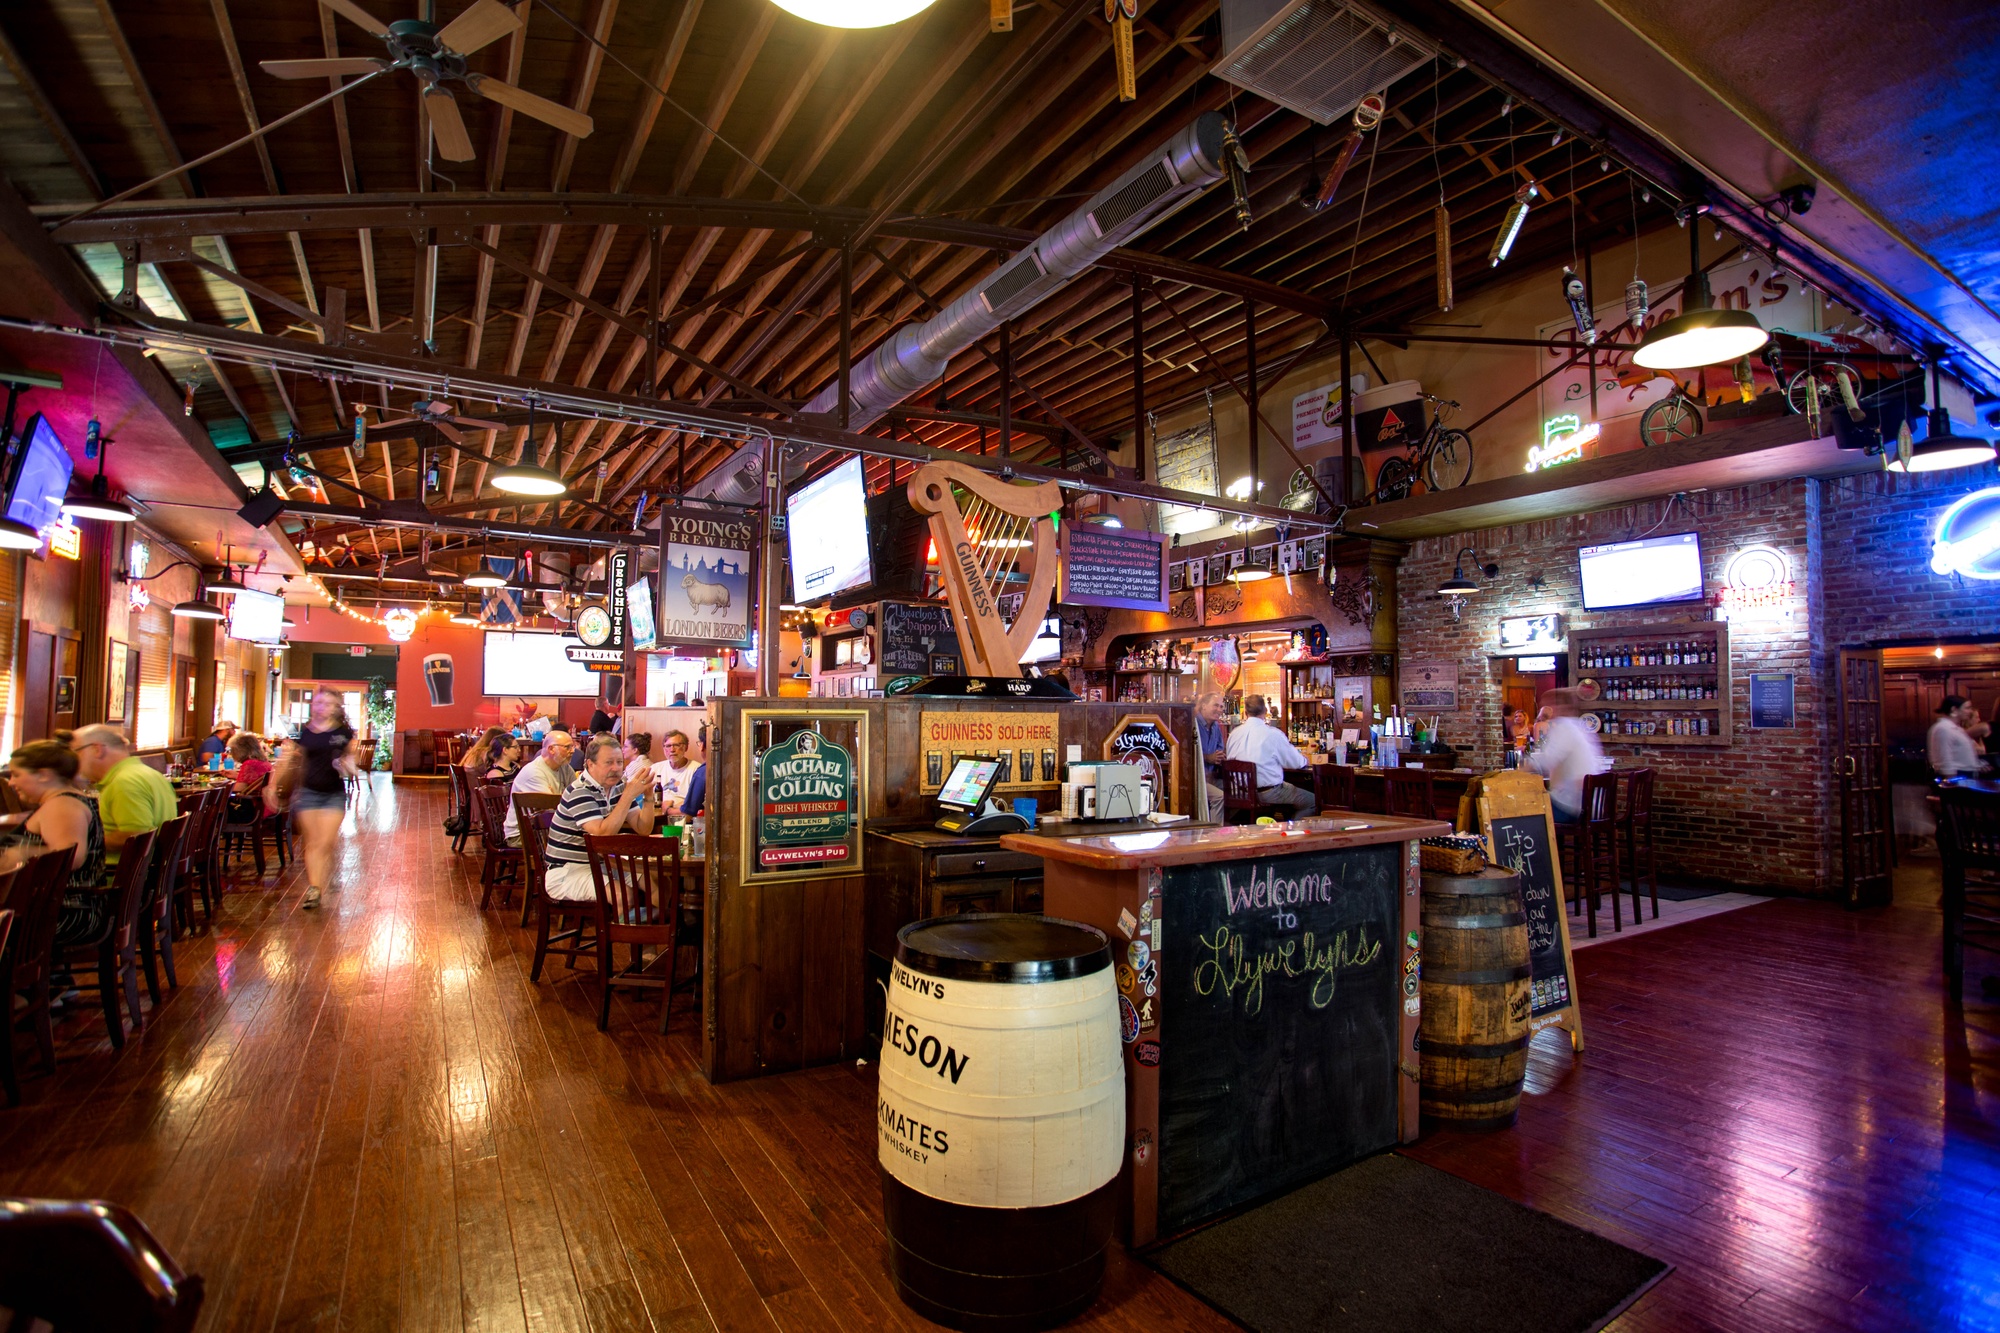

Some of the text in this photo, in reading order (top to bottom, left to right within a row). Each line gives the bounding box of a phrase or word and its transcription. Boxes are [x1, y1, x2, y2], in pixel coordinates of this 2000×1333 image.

[1124, 25, 1134, 94] DESCHUTES
[1359, 106, 1379, 120] KILLIAN'S
[1296, 394, 1324, 408] AMERICA'S
[1296, 407, 1322, 419] PREMIUM
[1296, 420, 1318, 432] QUALITY
[1296, 433, 1312, 442] BEER
[669, 516, 751, 540] YOUNG'S
[669, 532, 750, 550] BREWERY
[956, 542, 992, 618] GUINNESS
[614, 558, 626, 645] DESCHUTES
[666, 618, 746, 640] LONDON BEERS
[908, 618, 937, 636] happy
[572, 650, 624, 660] BREWERY
[1007, 683, 1032, 692] HARP
[931, 722, 1051, 741] GUINNESS SOLD HERE
[1115, 731, 1166, 751] Llywelyn's
[772, 760, 843, 780] MICHAEL
[768, 780, 845, 801] COLLINS
[774, 802, 839, 814] IRISH WHISKEY
[1502, 824, 1534, 849] It's
[765, 850, 824, 860] LLYWELYN'S
[1220, 864, 1332, 916] Welcome
[1526, 884, 1550, 901] down
[1272, 906, 1298, 930] to
[1530, 905, 1546, 920] our
[1530, 938, 1551, 950] onth
[884, 1131, 929, 1166] WHISKEY
